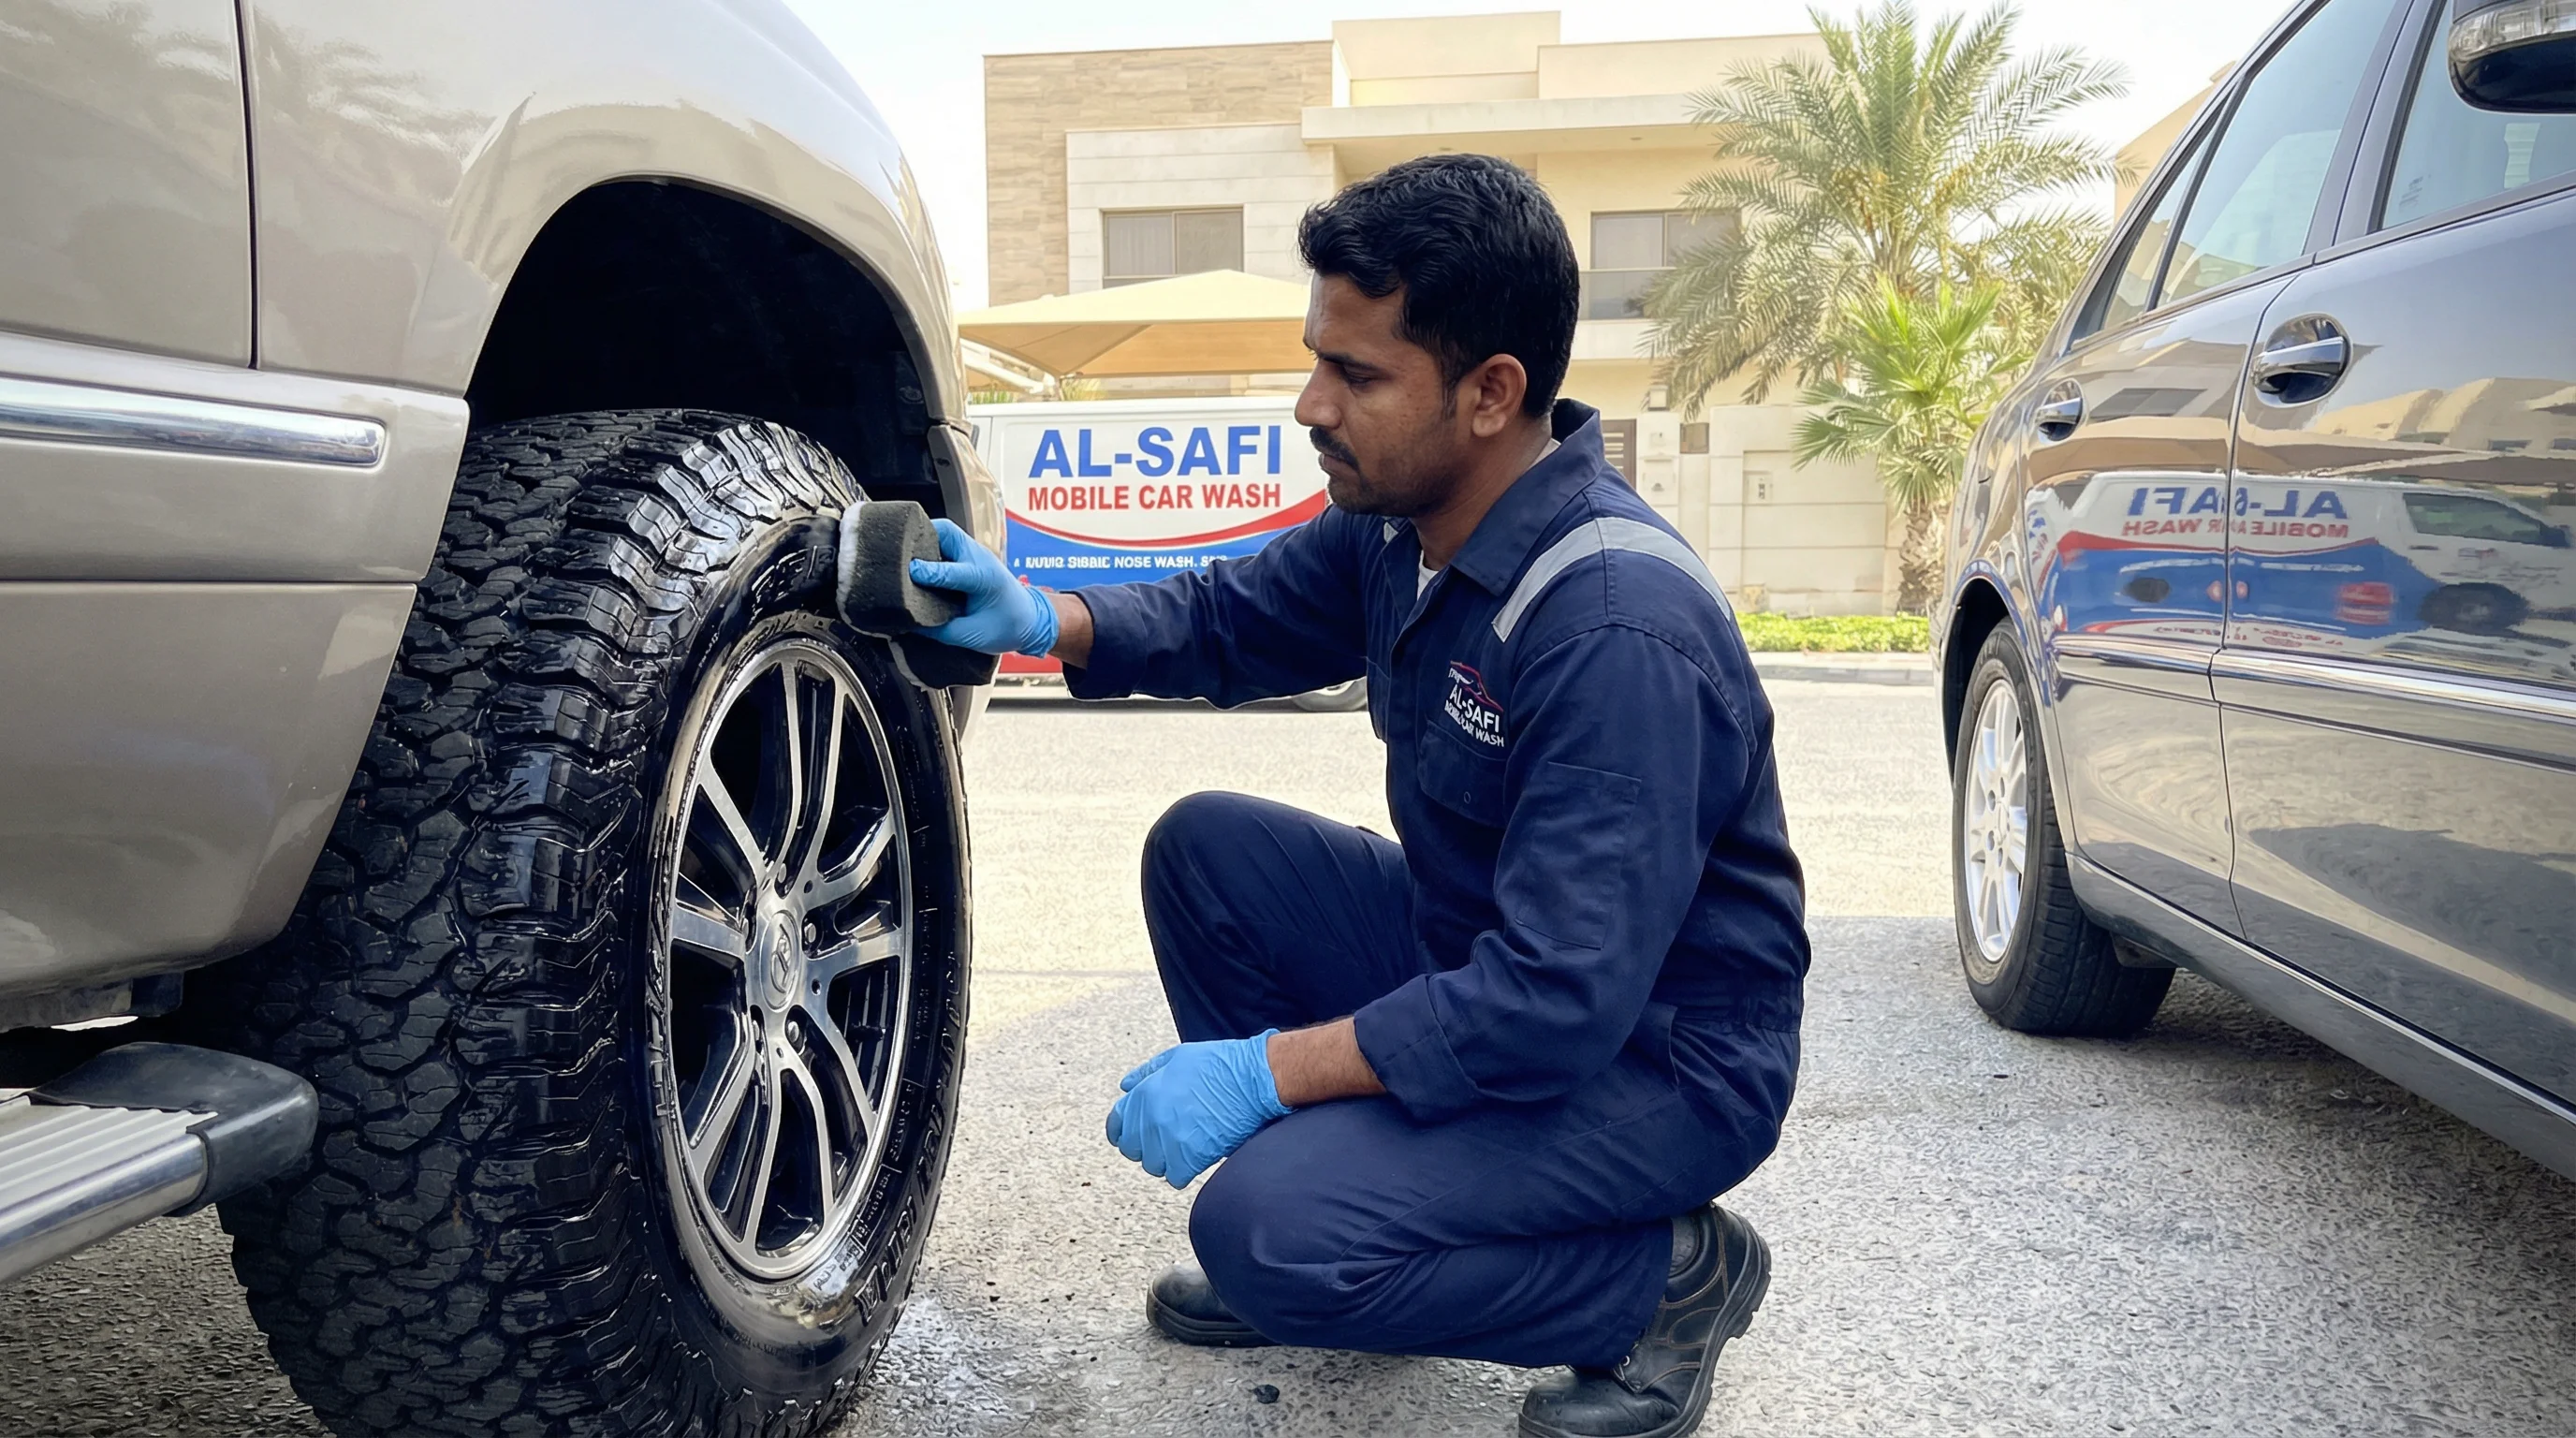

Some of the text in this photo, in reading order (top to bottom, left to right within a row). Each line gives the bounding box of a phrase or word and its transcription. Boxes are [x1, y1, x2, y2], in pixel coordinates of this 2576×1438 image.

[1029, 425, 1281, 478] AL-SAFI
[1029, 483, 1281, 511] MOBILE CAR WASH
[1114, 556, 1151, 567] NOSE
[1154, 555, 1198, 567] WASH.
[1449, 683, 1500, 732] AL-SAFI
[1475, 727, 1504, 747] WASH
